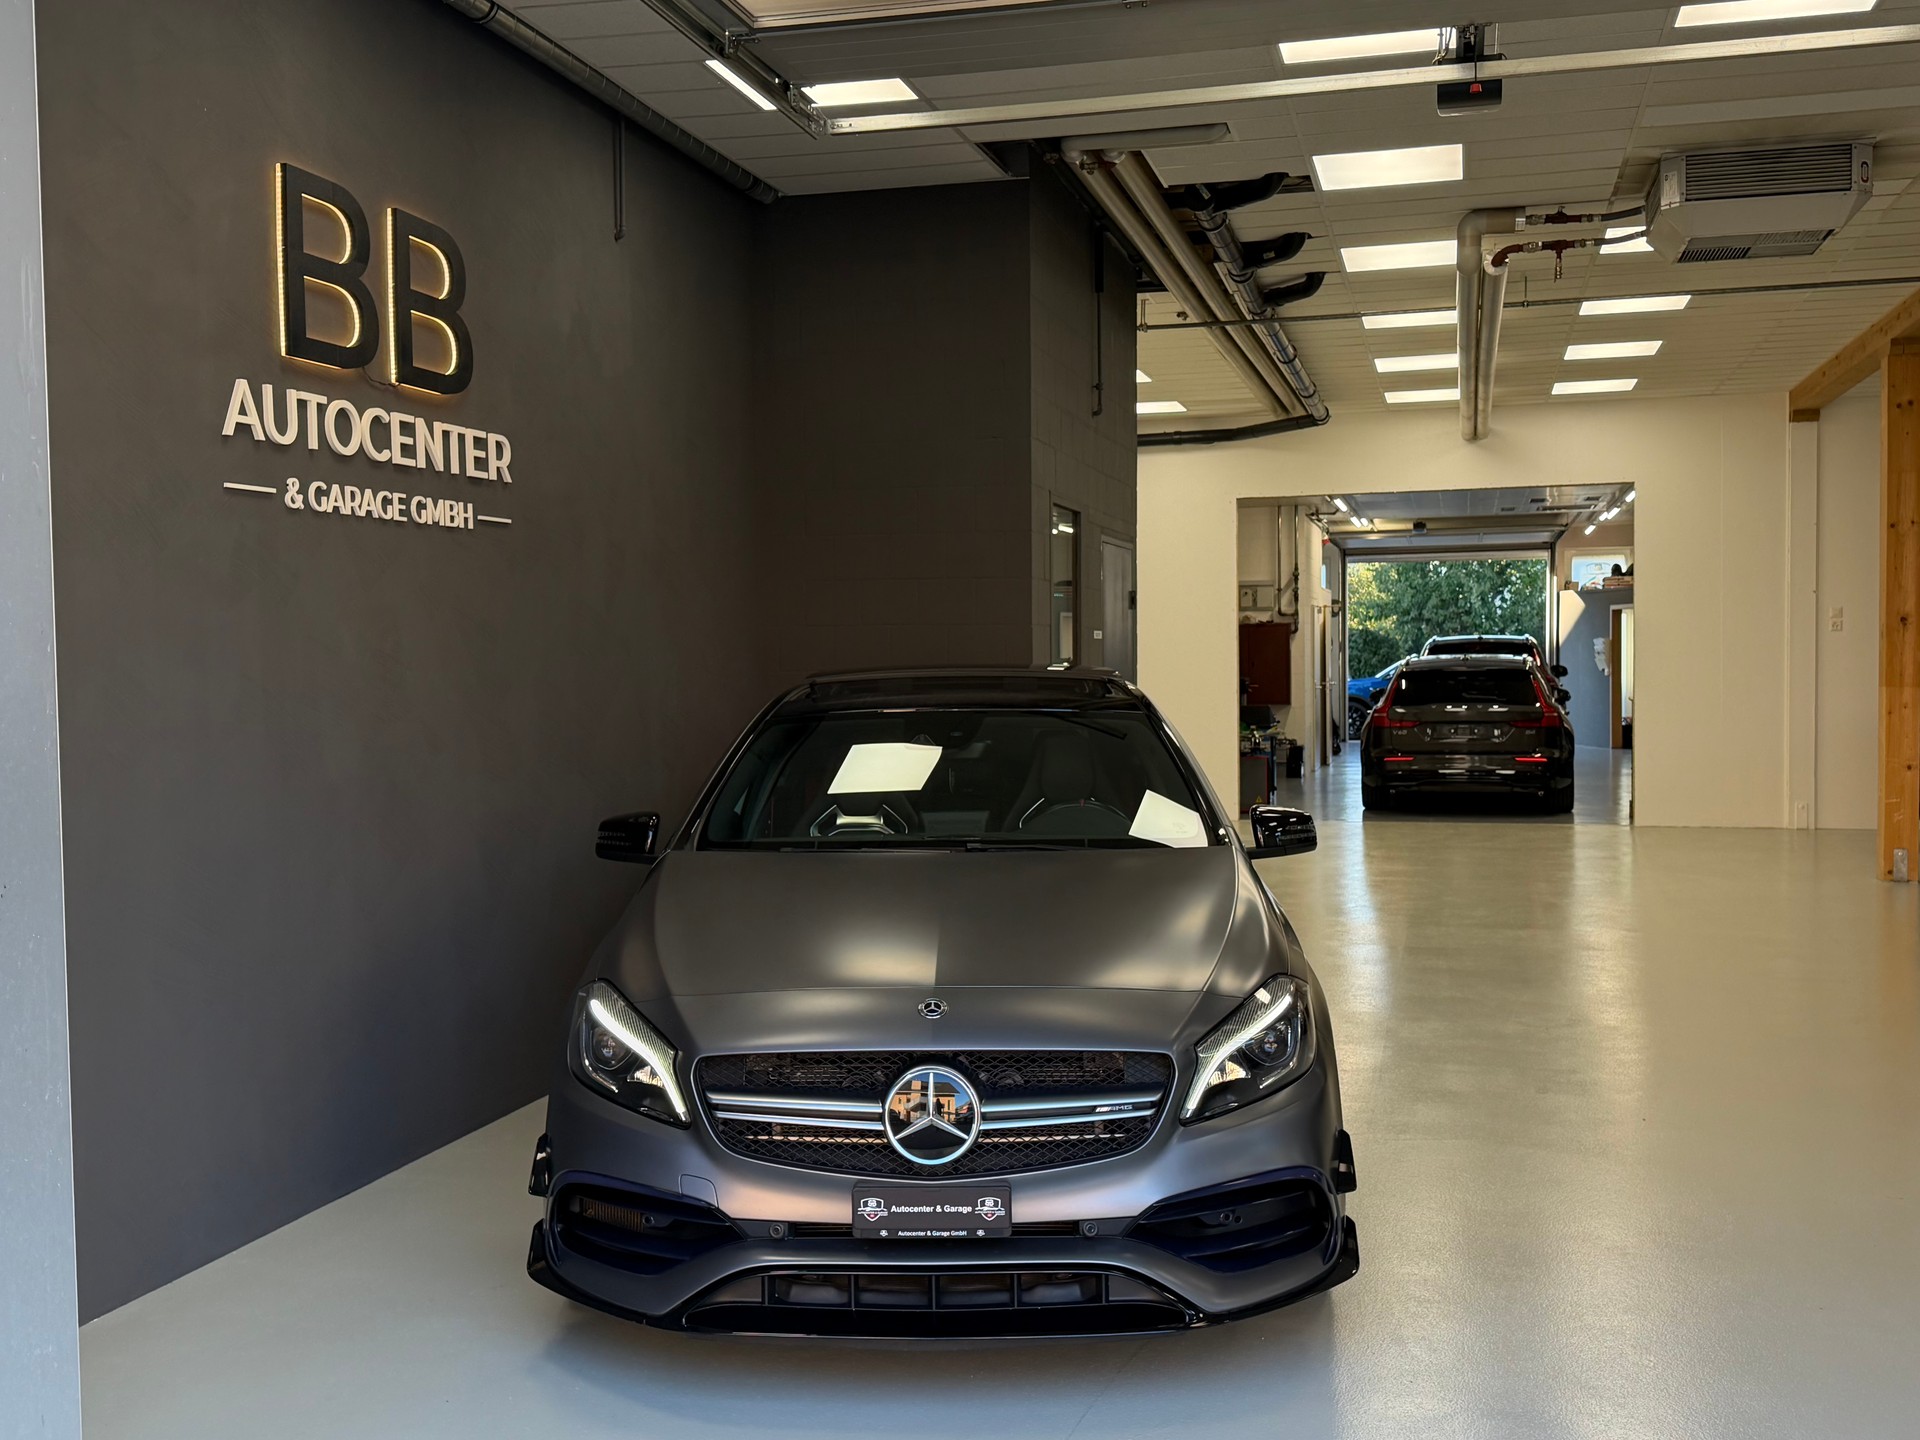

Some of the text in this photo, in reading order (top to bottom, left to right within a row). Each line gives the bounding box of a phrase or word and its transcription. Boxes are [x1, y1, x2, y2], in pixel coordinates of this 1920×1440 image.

[275, 162, 474, 395] BB
[222, 378, 512, 483] AUTOCENTER
[284, 477, 474, 529] & GARAGE GMBH
[890, 1205, 934, 1213] Autocenter
[936, 1204, 943, 1213] &
[944, 1205, 972, 1214] Garage
